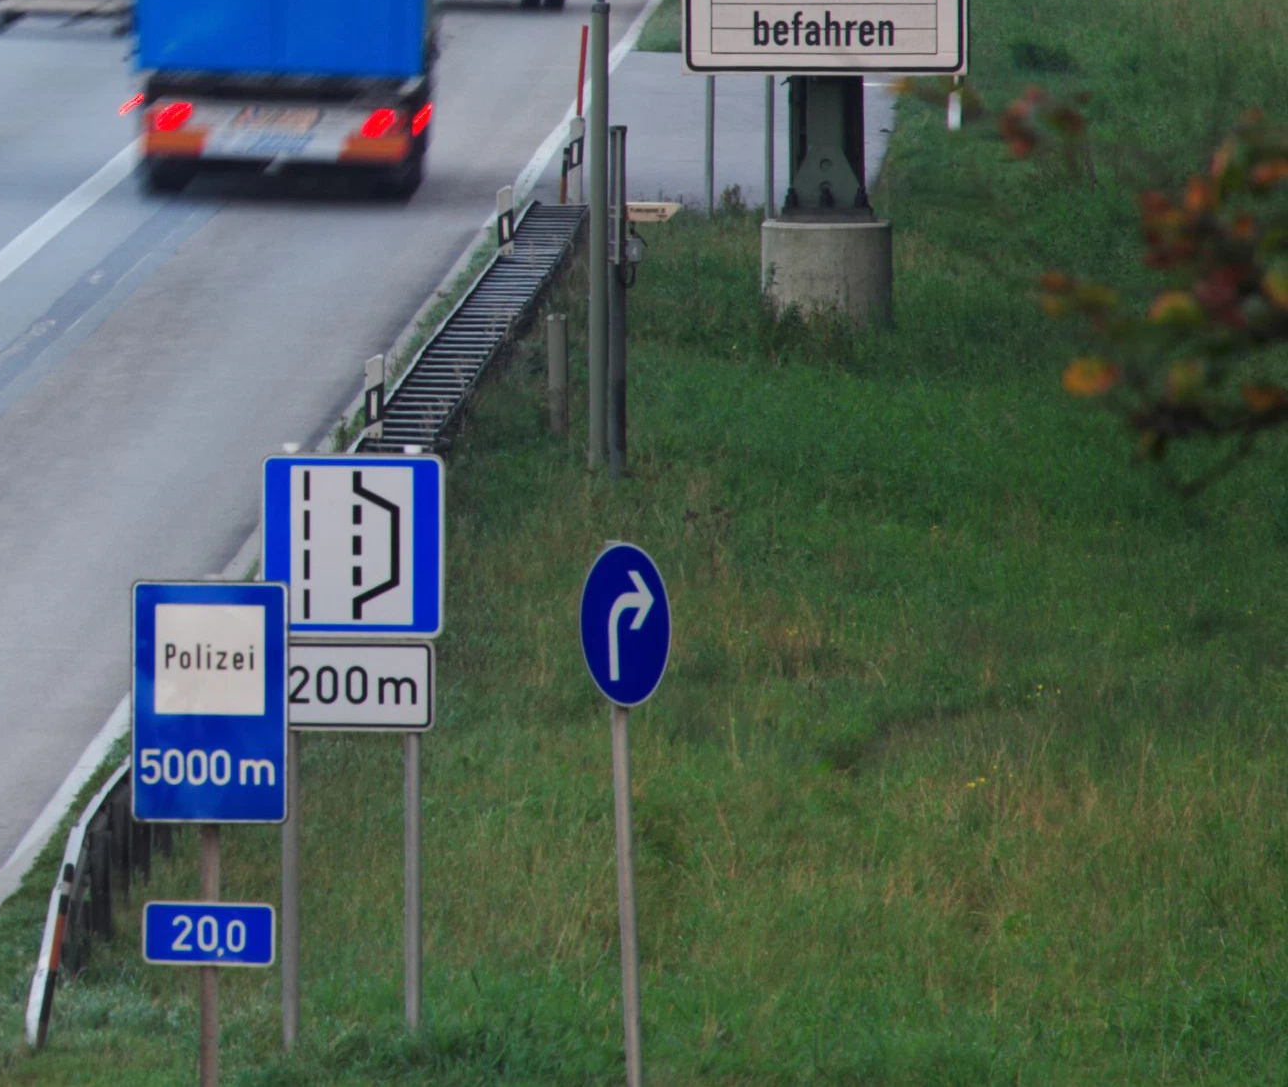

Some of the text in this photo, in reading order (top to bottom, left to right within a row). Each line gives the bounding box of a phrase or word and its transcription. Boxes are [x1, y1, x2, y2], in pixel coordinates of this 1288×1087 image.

[753, 10, 895, 46] befahren
[165, 643, 255, 671] Polizei
[289, 665, 418, 705] 200 m
[140, 748, 276, 786] 5000 m
[171, 915, 246, 957] 20,0
